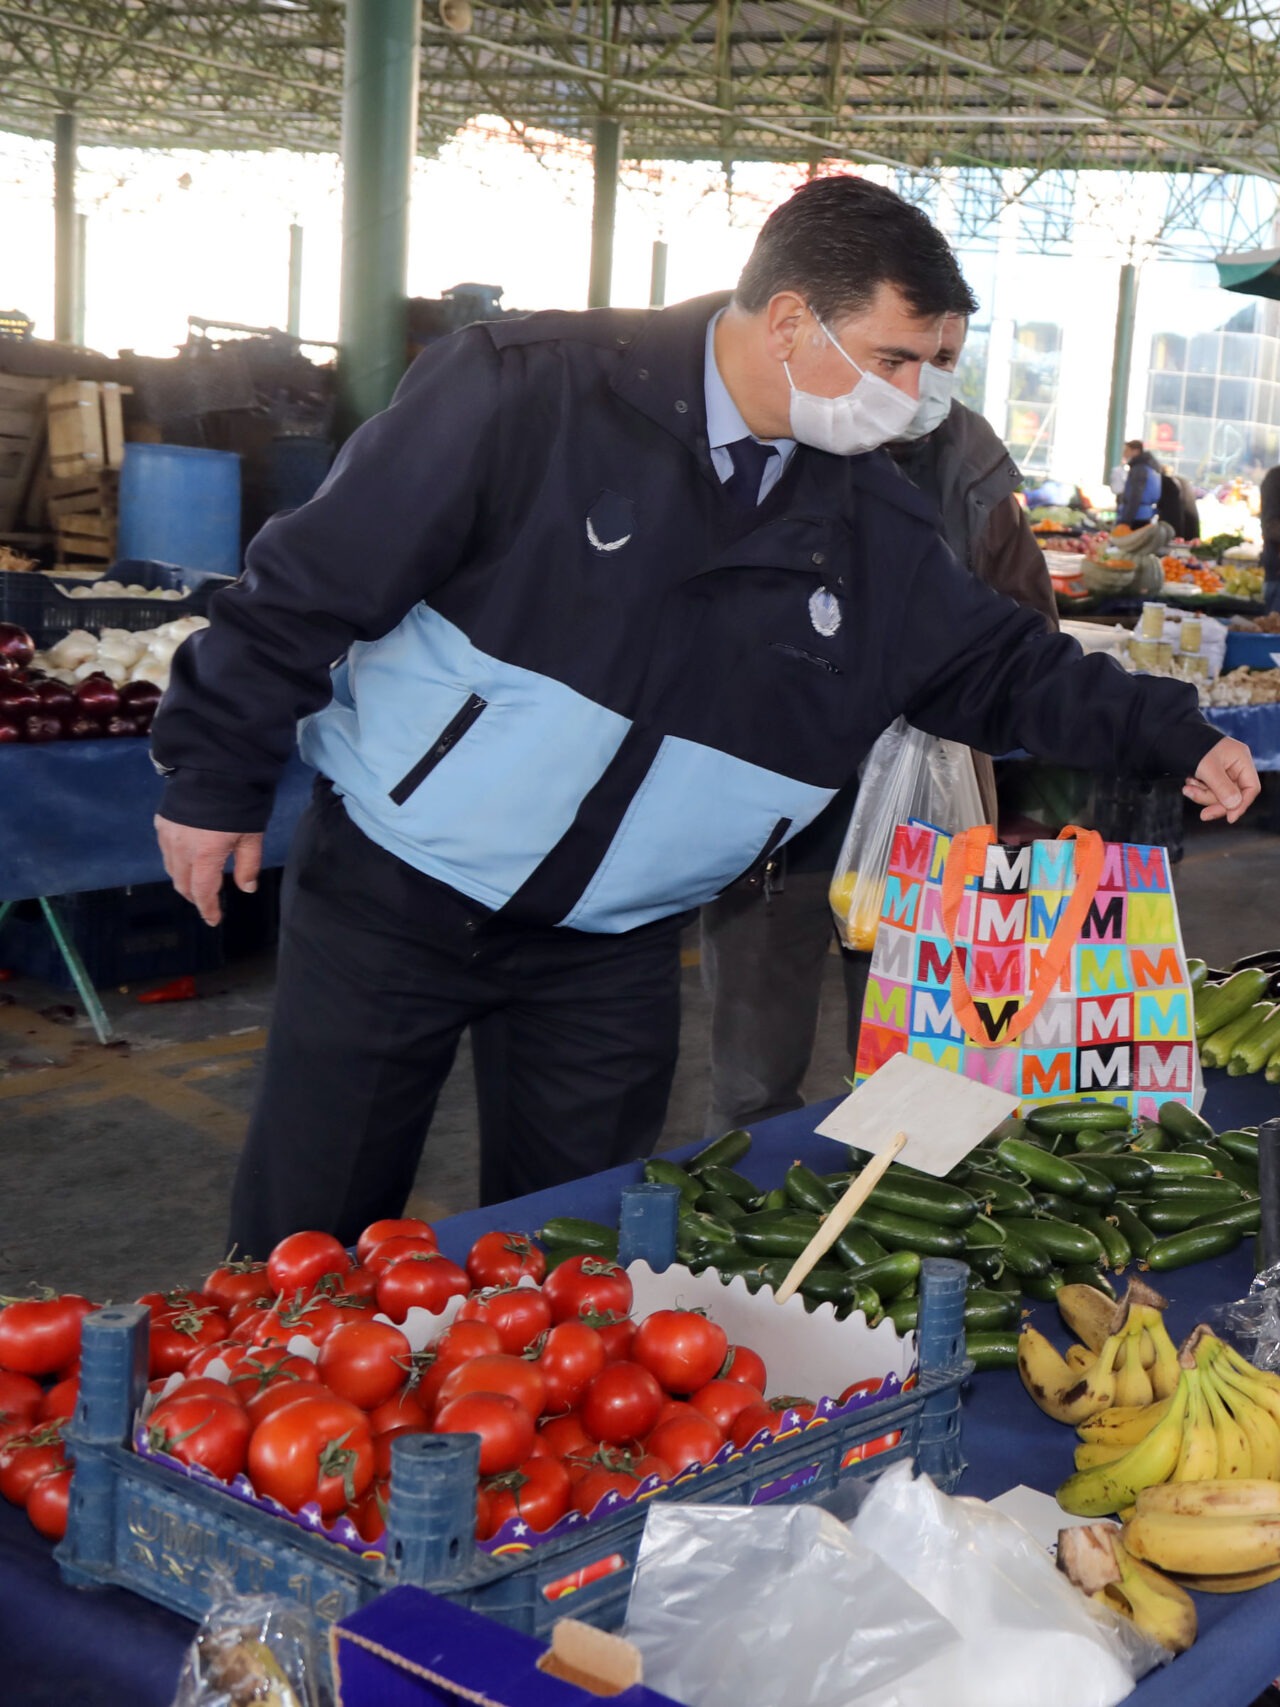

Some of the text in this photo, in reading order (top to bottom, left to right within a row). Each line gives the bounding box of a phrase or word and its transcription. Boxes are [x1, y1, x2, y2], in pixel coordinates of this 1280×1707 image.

[890, 825, 933, 874] M
[983, 844, 1031, 890] M
[1031, 842, 1074, 886] M
[1127, 846, 1167, 889] M
[880, 875, 921, 927] M
[977, 898, 1027, 942] M
[1081, 896, 1124, 939] M
[1129, 896, 1174, 939] M
[872, 927, 911, 979] M
[917, 940, 967, 984] M
[974, 949, 1021, 992] M
[1080, 949, 1128, 992] M
[1130, 947, 1184, 987] M
[864, 978, 907, 1028] M
[913, 990, 962, 1038] M
[1080, 997, 1130, 1042] M
[1139, 994, 1188, 1036] M
[1022, 1052, 1071, 1094] M
[1080, 1046, 1130, 1088] M
[1138, 1045, 1189, 1087] M
